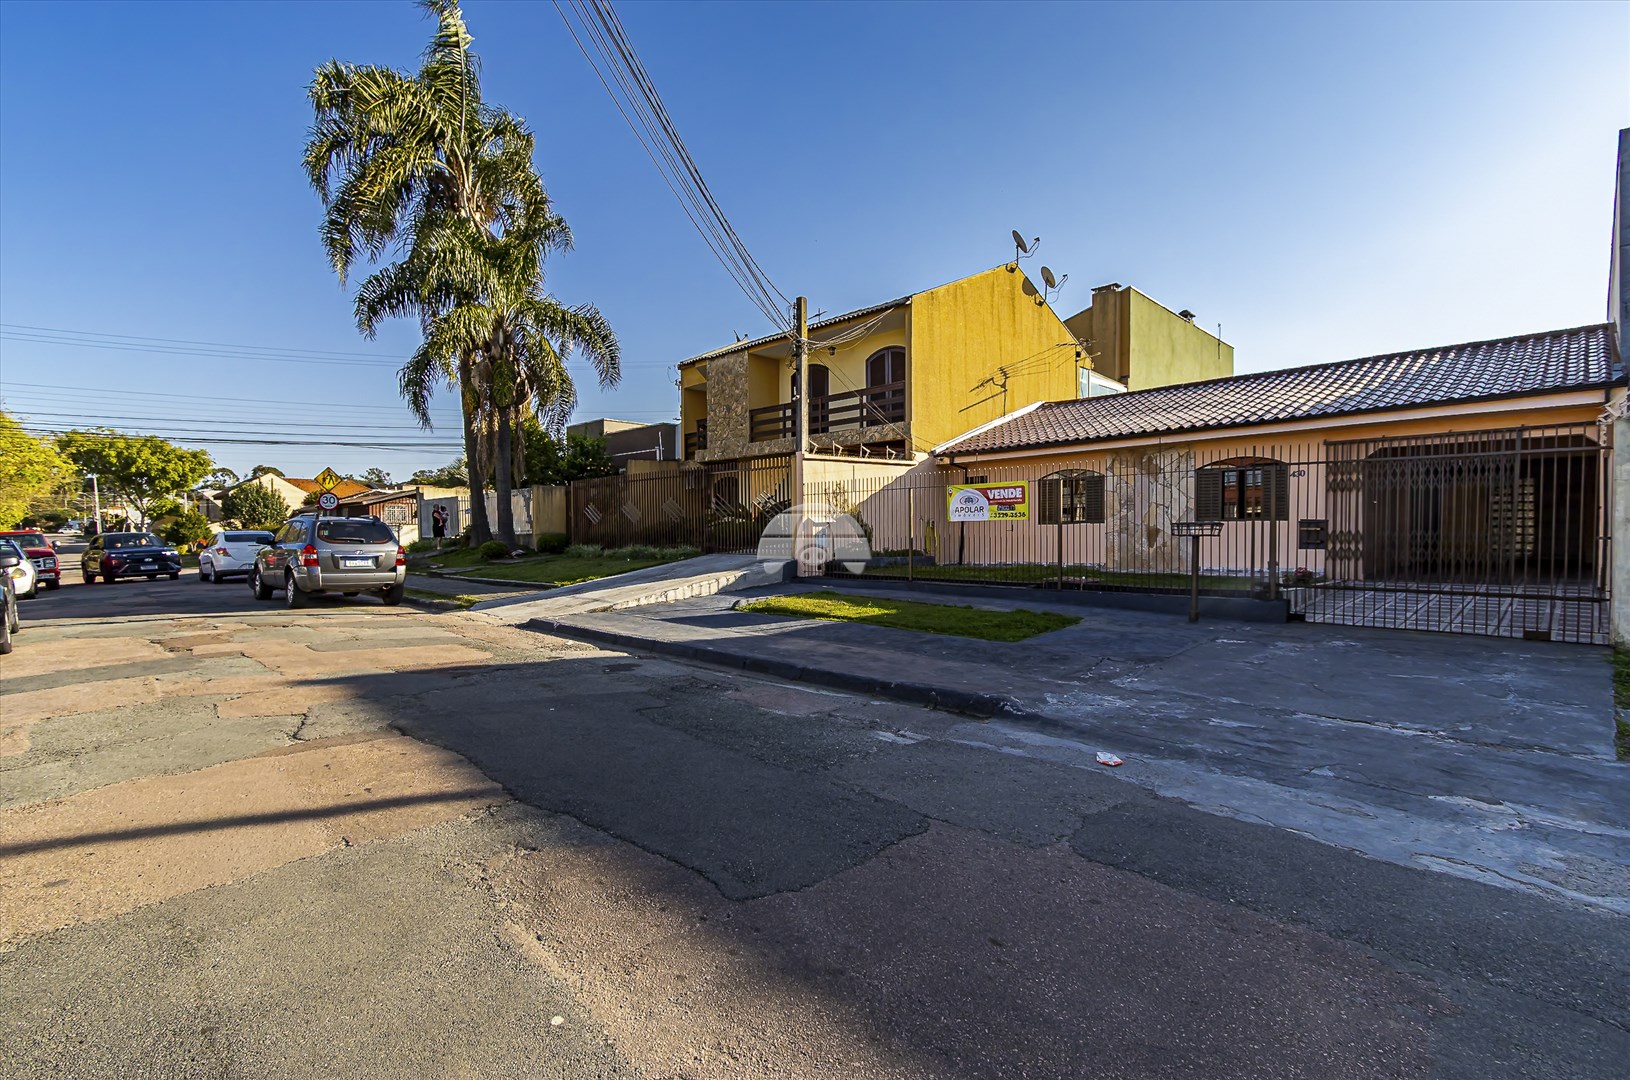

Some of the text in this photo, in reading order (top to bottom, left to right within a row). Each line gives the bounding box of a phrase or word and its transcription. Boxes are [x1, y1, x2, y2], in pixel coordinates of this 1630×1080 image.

[1290, 470, 1306, 478] 430
[987, 488, 1022, 499] VENDE
[322, 496, 336, 504] 30
[955, 505, 985, 513] APOLAR
